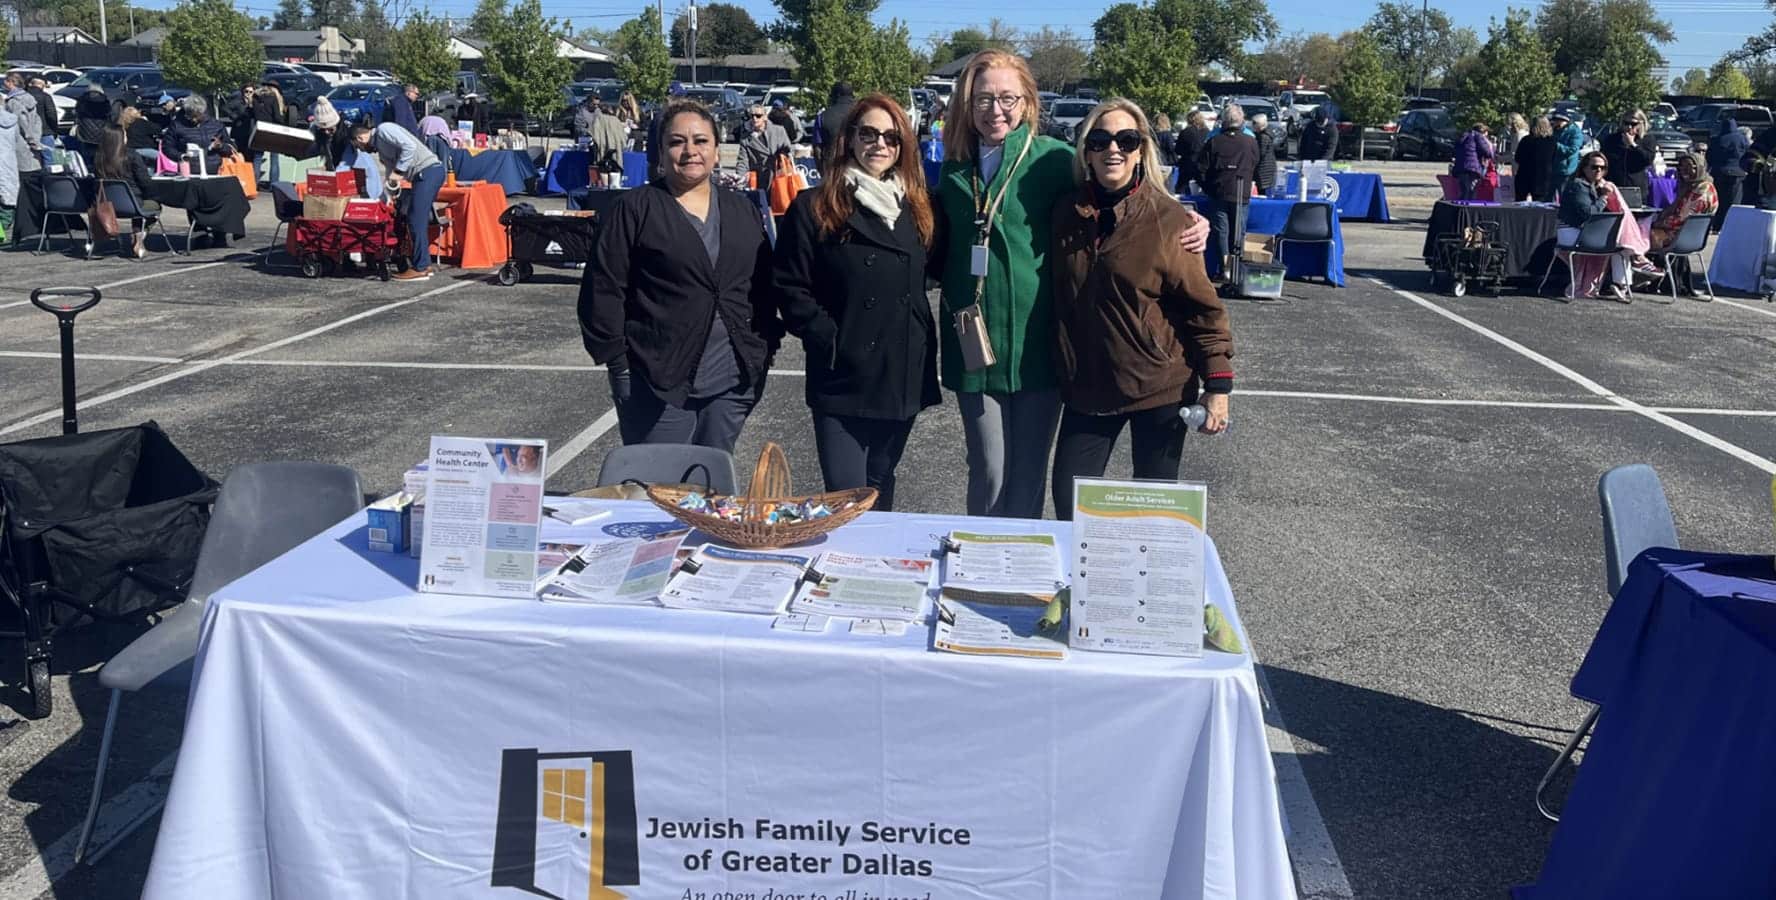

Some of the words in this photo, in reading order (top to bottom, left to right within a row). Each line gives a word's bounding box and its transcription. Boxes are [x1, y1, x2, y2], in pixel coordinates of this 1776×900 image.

[436, 448, 481, 458] Community
[436, 457, 461, 466] Health
[462, 459, 489, 468] Center
[645, 817, 744, 839] Jewish
[756, 819, 850, 846] Family
[861, 821, 971, 845] Service
[683, 849, 712, 871] of
[722, 850, 832, 873] Greater
[843, 853, 932, 877] Dallas
